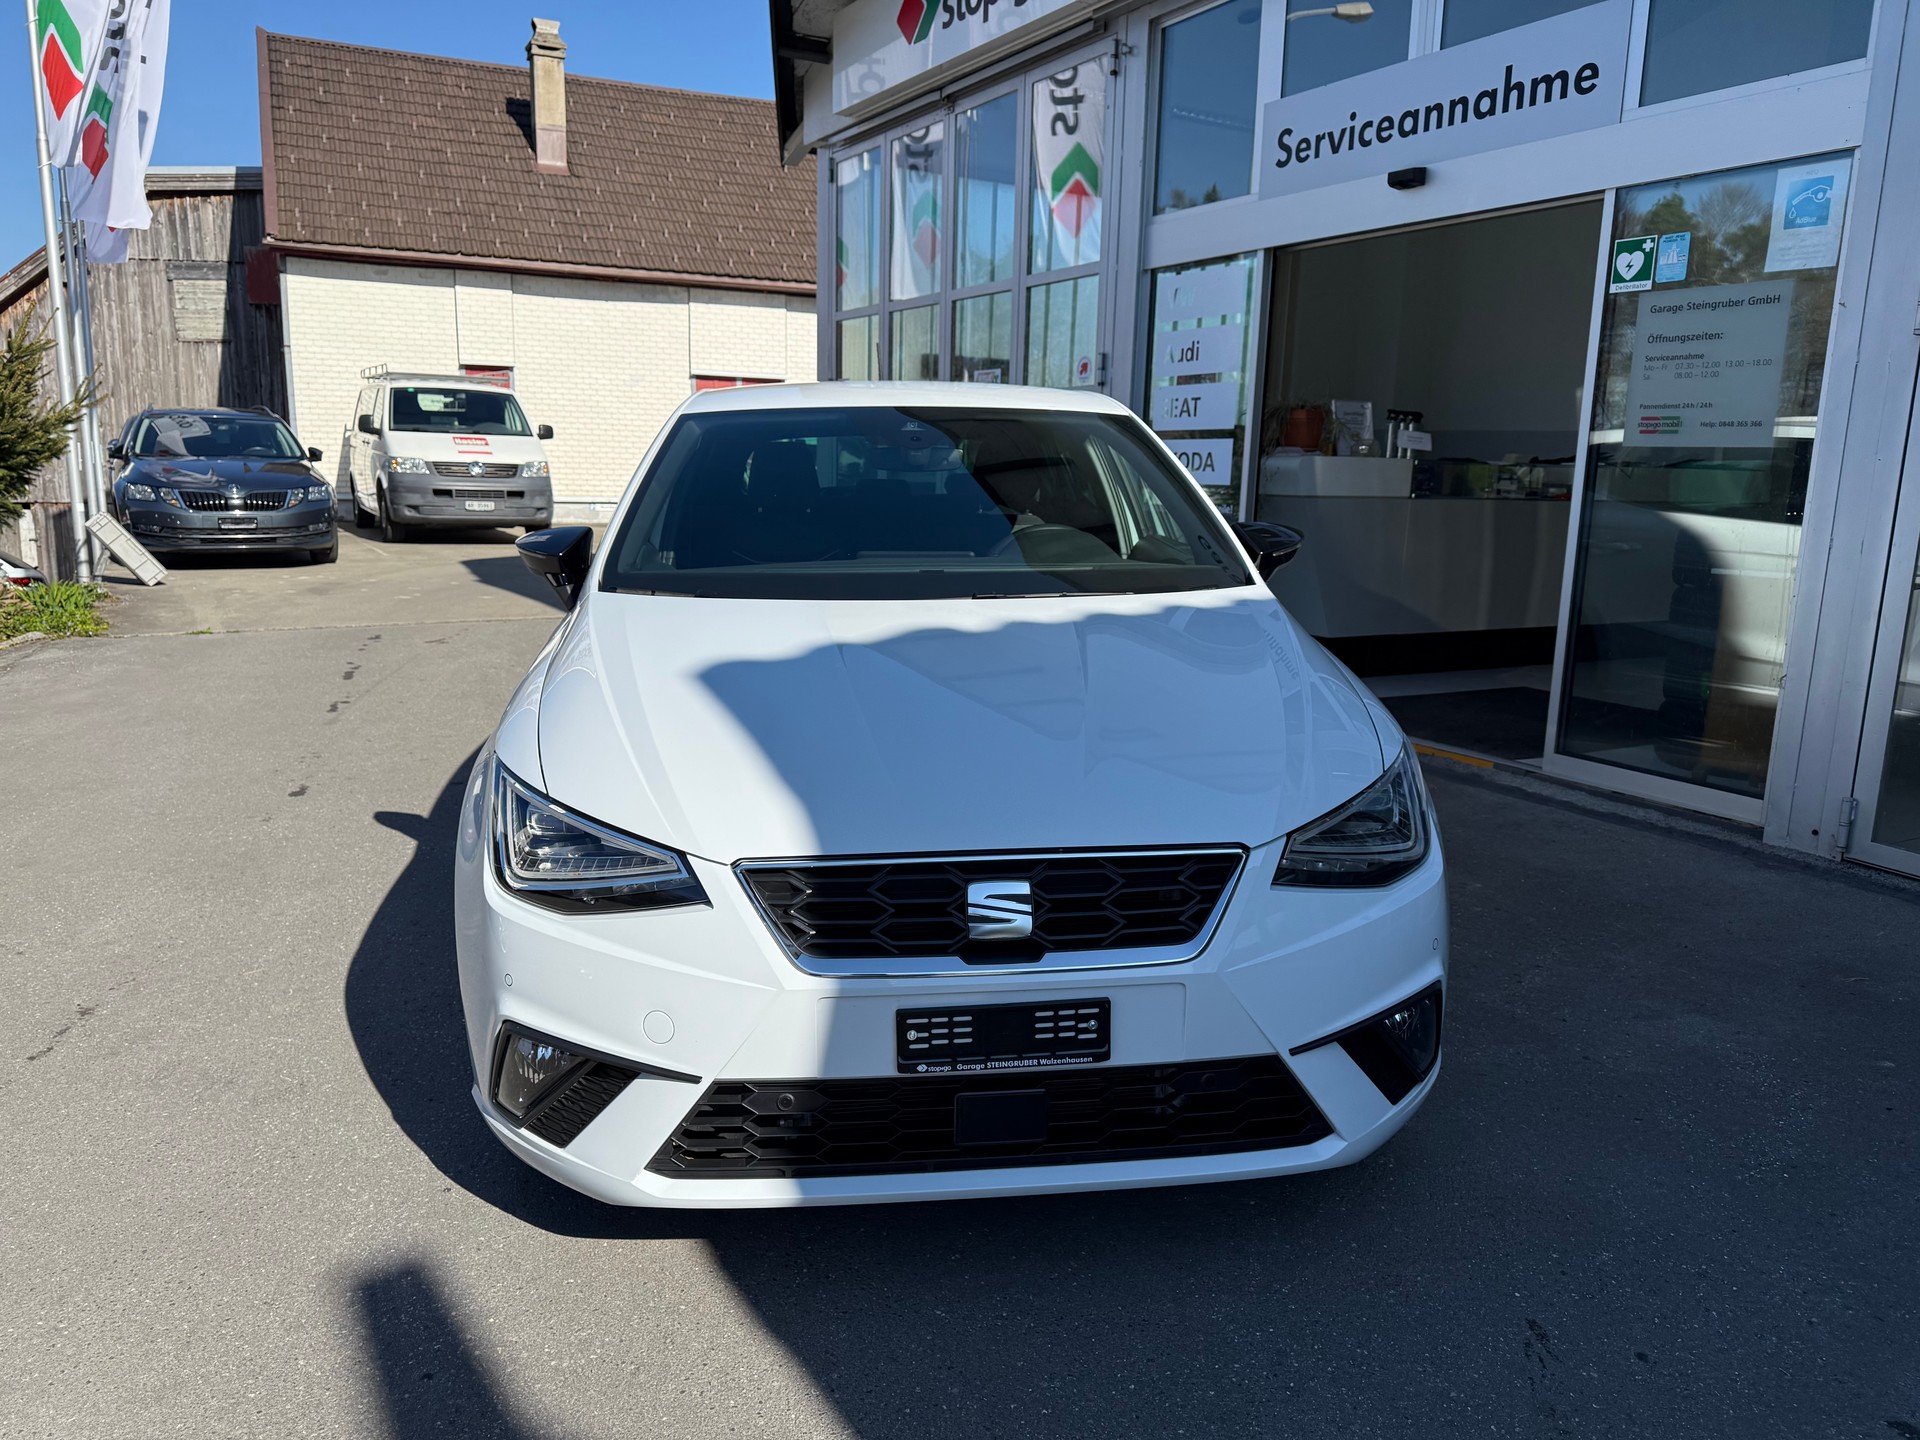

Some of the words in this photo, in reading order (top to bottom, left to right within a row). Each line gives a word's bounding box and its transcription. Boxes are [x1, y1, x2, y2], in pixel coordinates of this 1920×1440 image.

[1275, 61, 1600, 169] Serviceannahme
[1615, 282, 1648, 291] Defibrillator
[1650, 304, 1684, 315] Garage
[1686, 297, 1746, 312] Steingruber
[1748, 294, 1781, 306] GmbH
[1647, 331, 1724, 344] Öffnungszeiten:
[1645, 352, 1705, 362] Serviceannahme
[1639, 402, 1681, 410] Pannendienst
[1700, 420, 1717, 428] Help:
[1718, 420, 1735, 428] 0848
[1174, 451, 1215, 472] ODA
[956, 1063, 985, 1071] Garage
[986, 1059, 1038, 1069] STEINGRUBER
[1039, 1056, 1093, 1065] Walzenhausen
